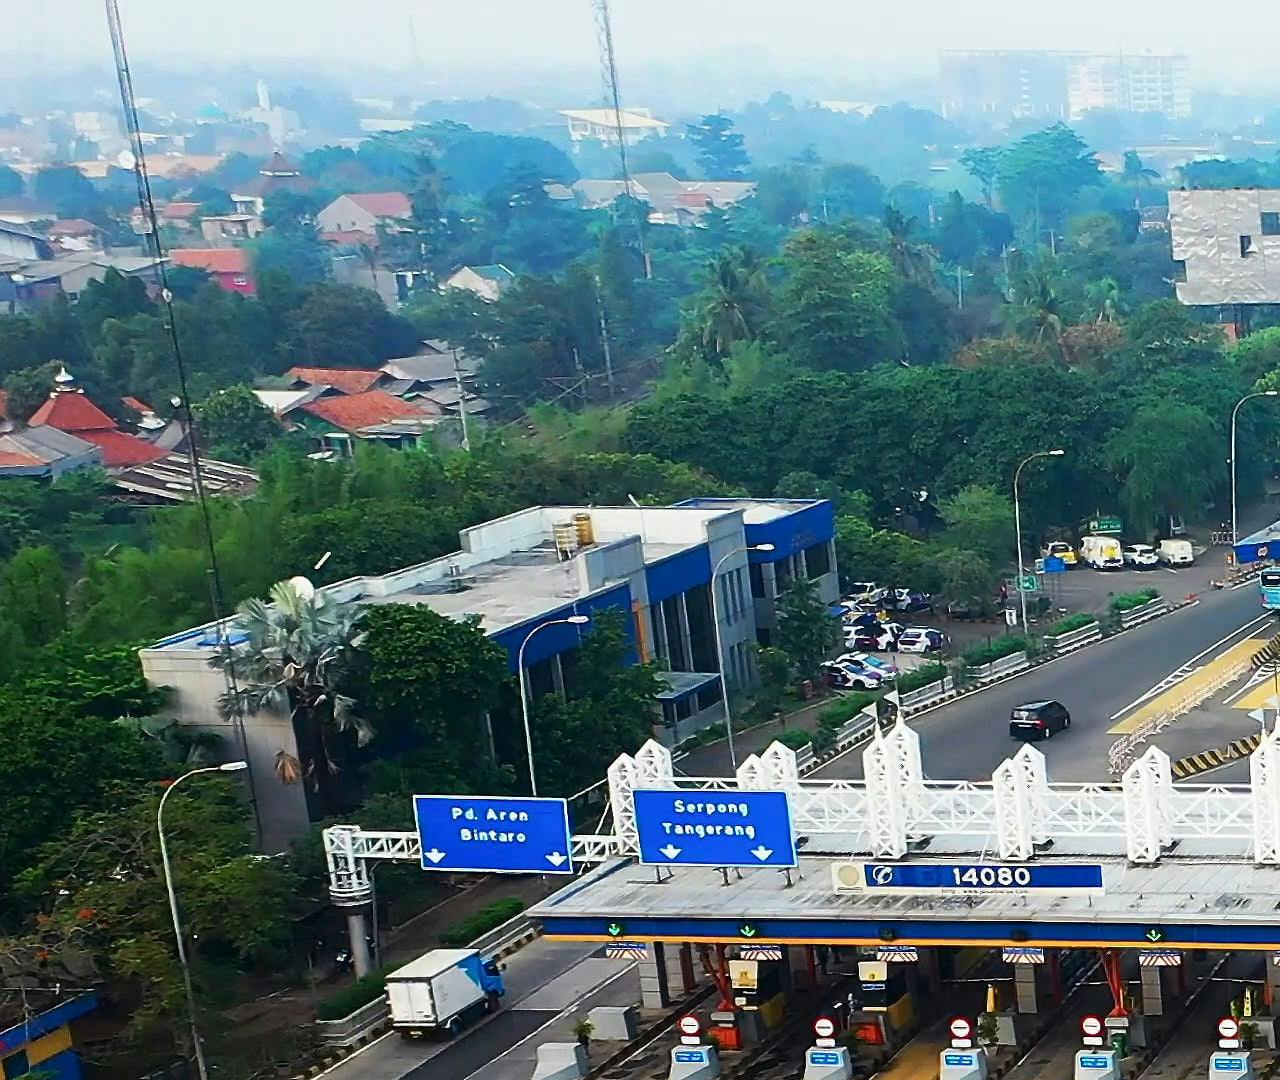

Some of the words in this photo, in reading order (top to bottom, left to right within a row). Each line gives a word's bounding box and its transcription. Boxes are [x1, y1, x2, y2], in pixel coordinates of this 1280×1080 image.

[452, 806, 478, 821] Pd.
[486, 806, 530, 822] Aren
[673, 799, 749, 818] Serpong
[460, 827, 527, 843] Bintaro
[662, 822, 757, 840] Tangerang
[952, 867, 1031, 886] 14080
